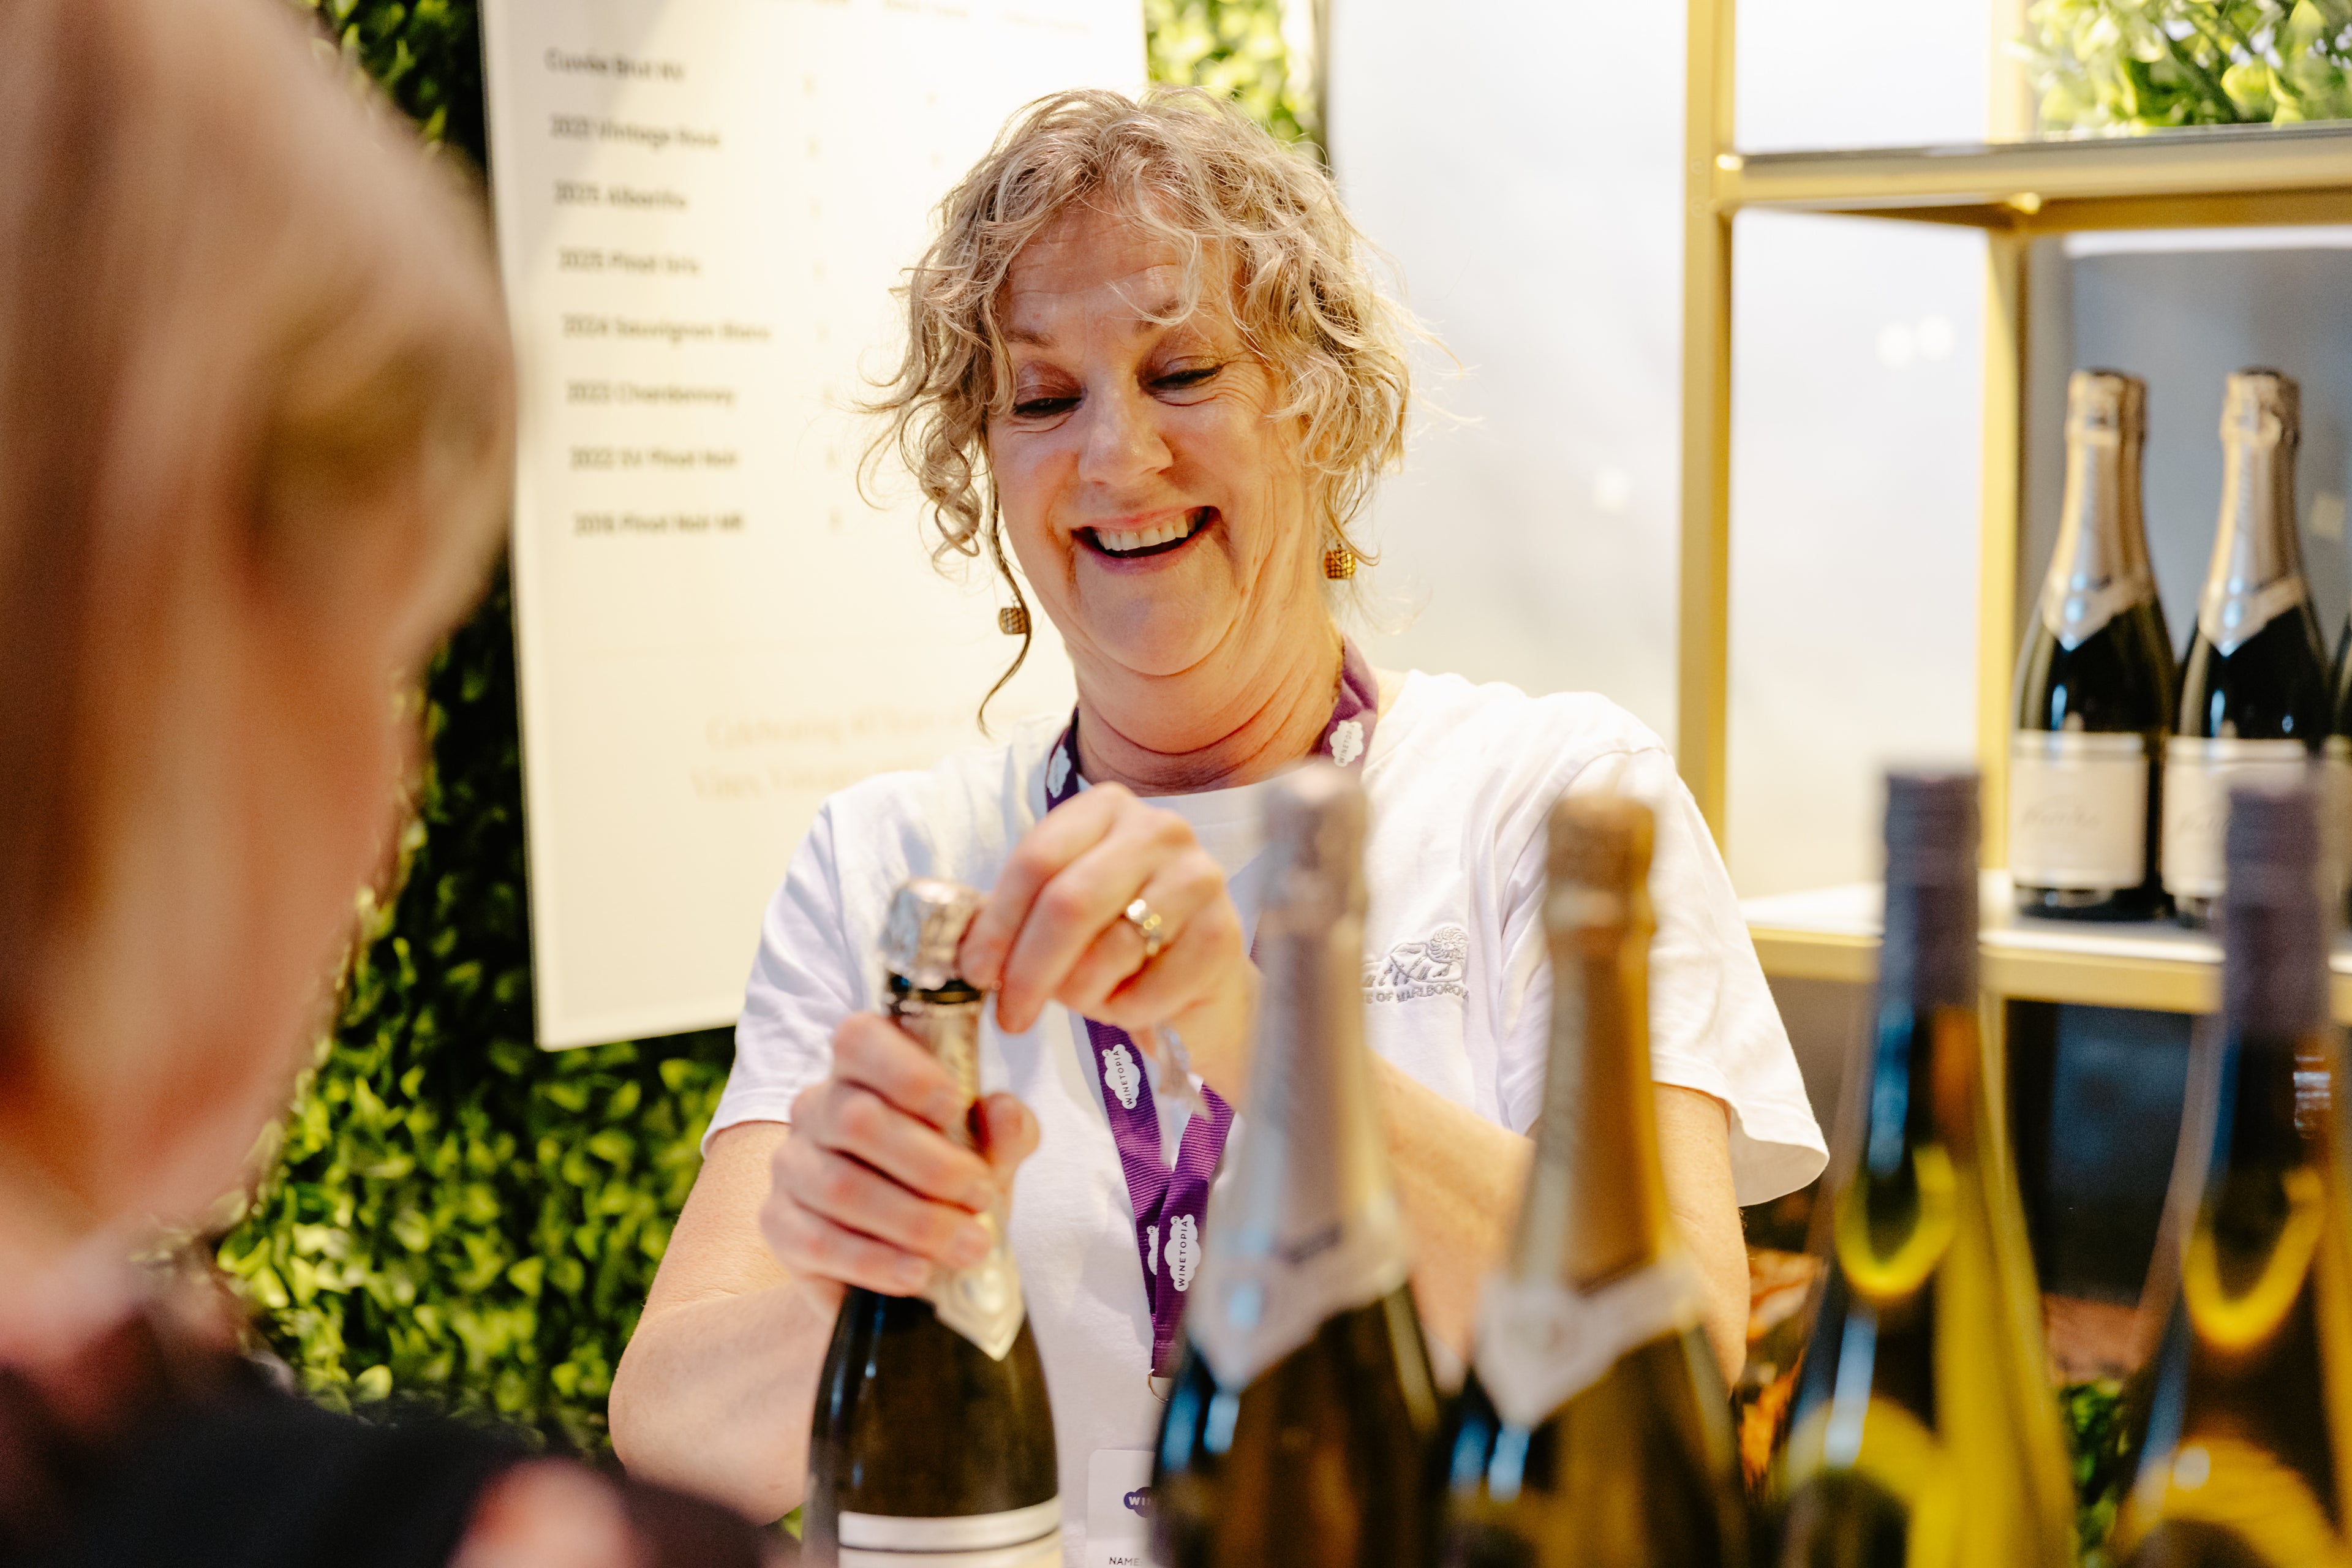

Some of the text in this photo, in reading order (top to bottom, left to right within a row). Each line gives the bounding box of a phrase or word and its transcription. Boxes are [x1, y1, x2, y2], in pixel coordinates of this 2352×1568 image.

[1114, 1050, 1133, 1106] WINETOPIA
[1178, 1221, 1188, 1287] WINETOPIA
[1109, 1557, 1140, 1566] NAME
